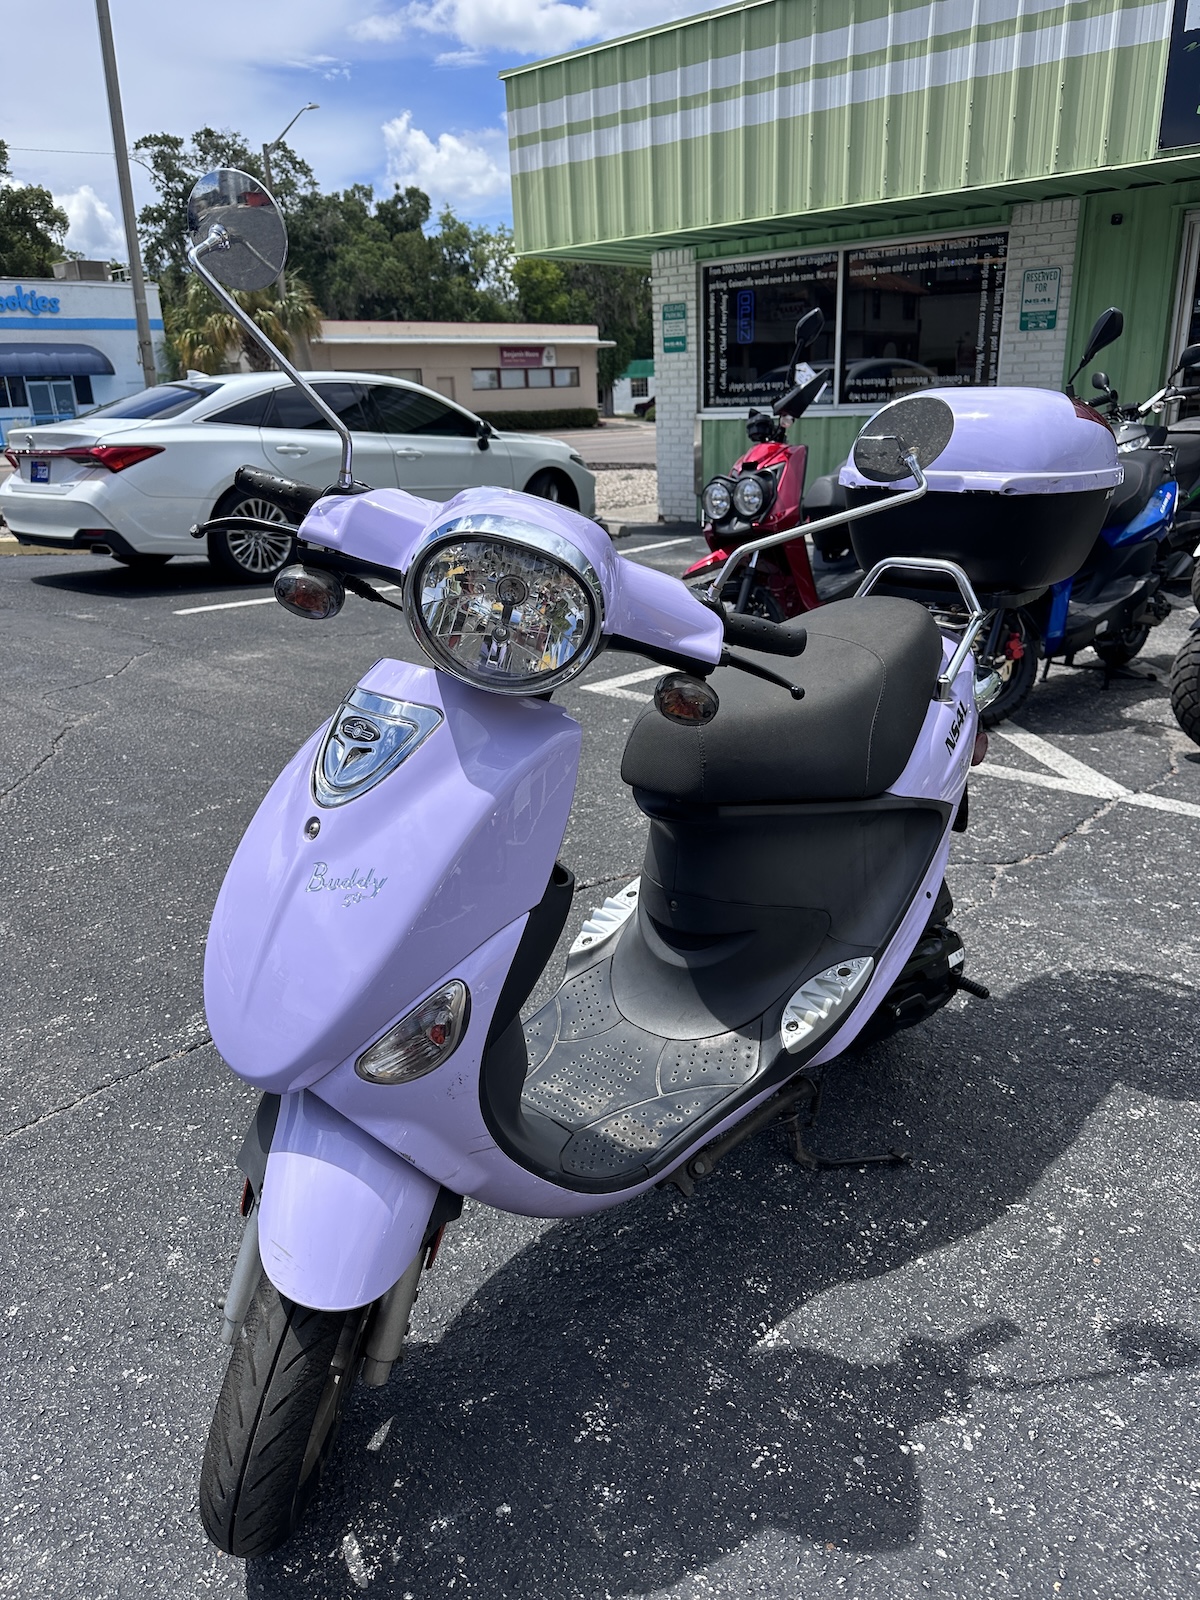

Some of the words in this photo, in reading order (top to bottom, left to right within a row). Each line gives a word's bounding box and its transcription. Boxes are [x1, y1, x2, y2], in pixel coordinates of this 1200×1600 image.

[761, 261, 769, 270] the
[777, 258, 796, 268] student
[796, 257, 807, 265] that
[808, 253, 832, 266] struggled
[849, 253, 859, 263] get
[859, 252, 865, 260] to
[885, 247, 899, 257] went
[900, 246, 906, 255] to
[907, 244, 916, 254] the
[917, 244, 928, 253] bus
[949, 239, 969, 249] waited
[971, 238, 978, 247] 15
[979, 236, 1004, 246] minutes
[998, 245, 1008, 256] for
[754, 275, 769, 285] would
[769, 276, 783, 284] never
[784, 273, 791, 283] be
[791, 272, 800, 281] the
[816, 270, 828, 279] Now
[849, 265, 876, 277] incredible
[877, 265, 891, 274] team
[892, 262, 903, 272] and
[908, 262, 918, 271] are
[919, 260, 929, 270] out
[930, 259, 936, 268] to
[937, 256, 965, 268] influence
[965, 254, 978, 264] and
[981, 253, 993, 278] change
[981, 279, 989, 289] an
[1026, 271, 1058, 282] RESERVED
[993, 287, 1004, 305] Then
[1035, 282, 1048, 293] FOR
[979, 290, 989, 311] entire
[992, 312, 1002, 332] drove
[990, 335, 999, 351] past
[990, 352, 997, 363] me
[974, 353, 985, 383] Welcome
[945, 700, 968, 757] NS4L
[305, 861, 388, 898] Buddy
